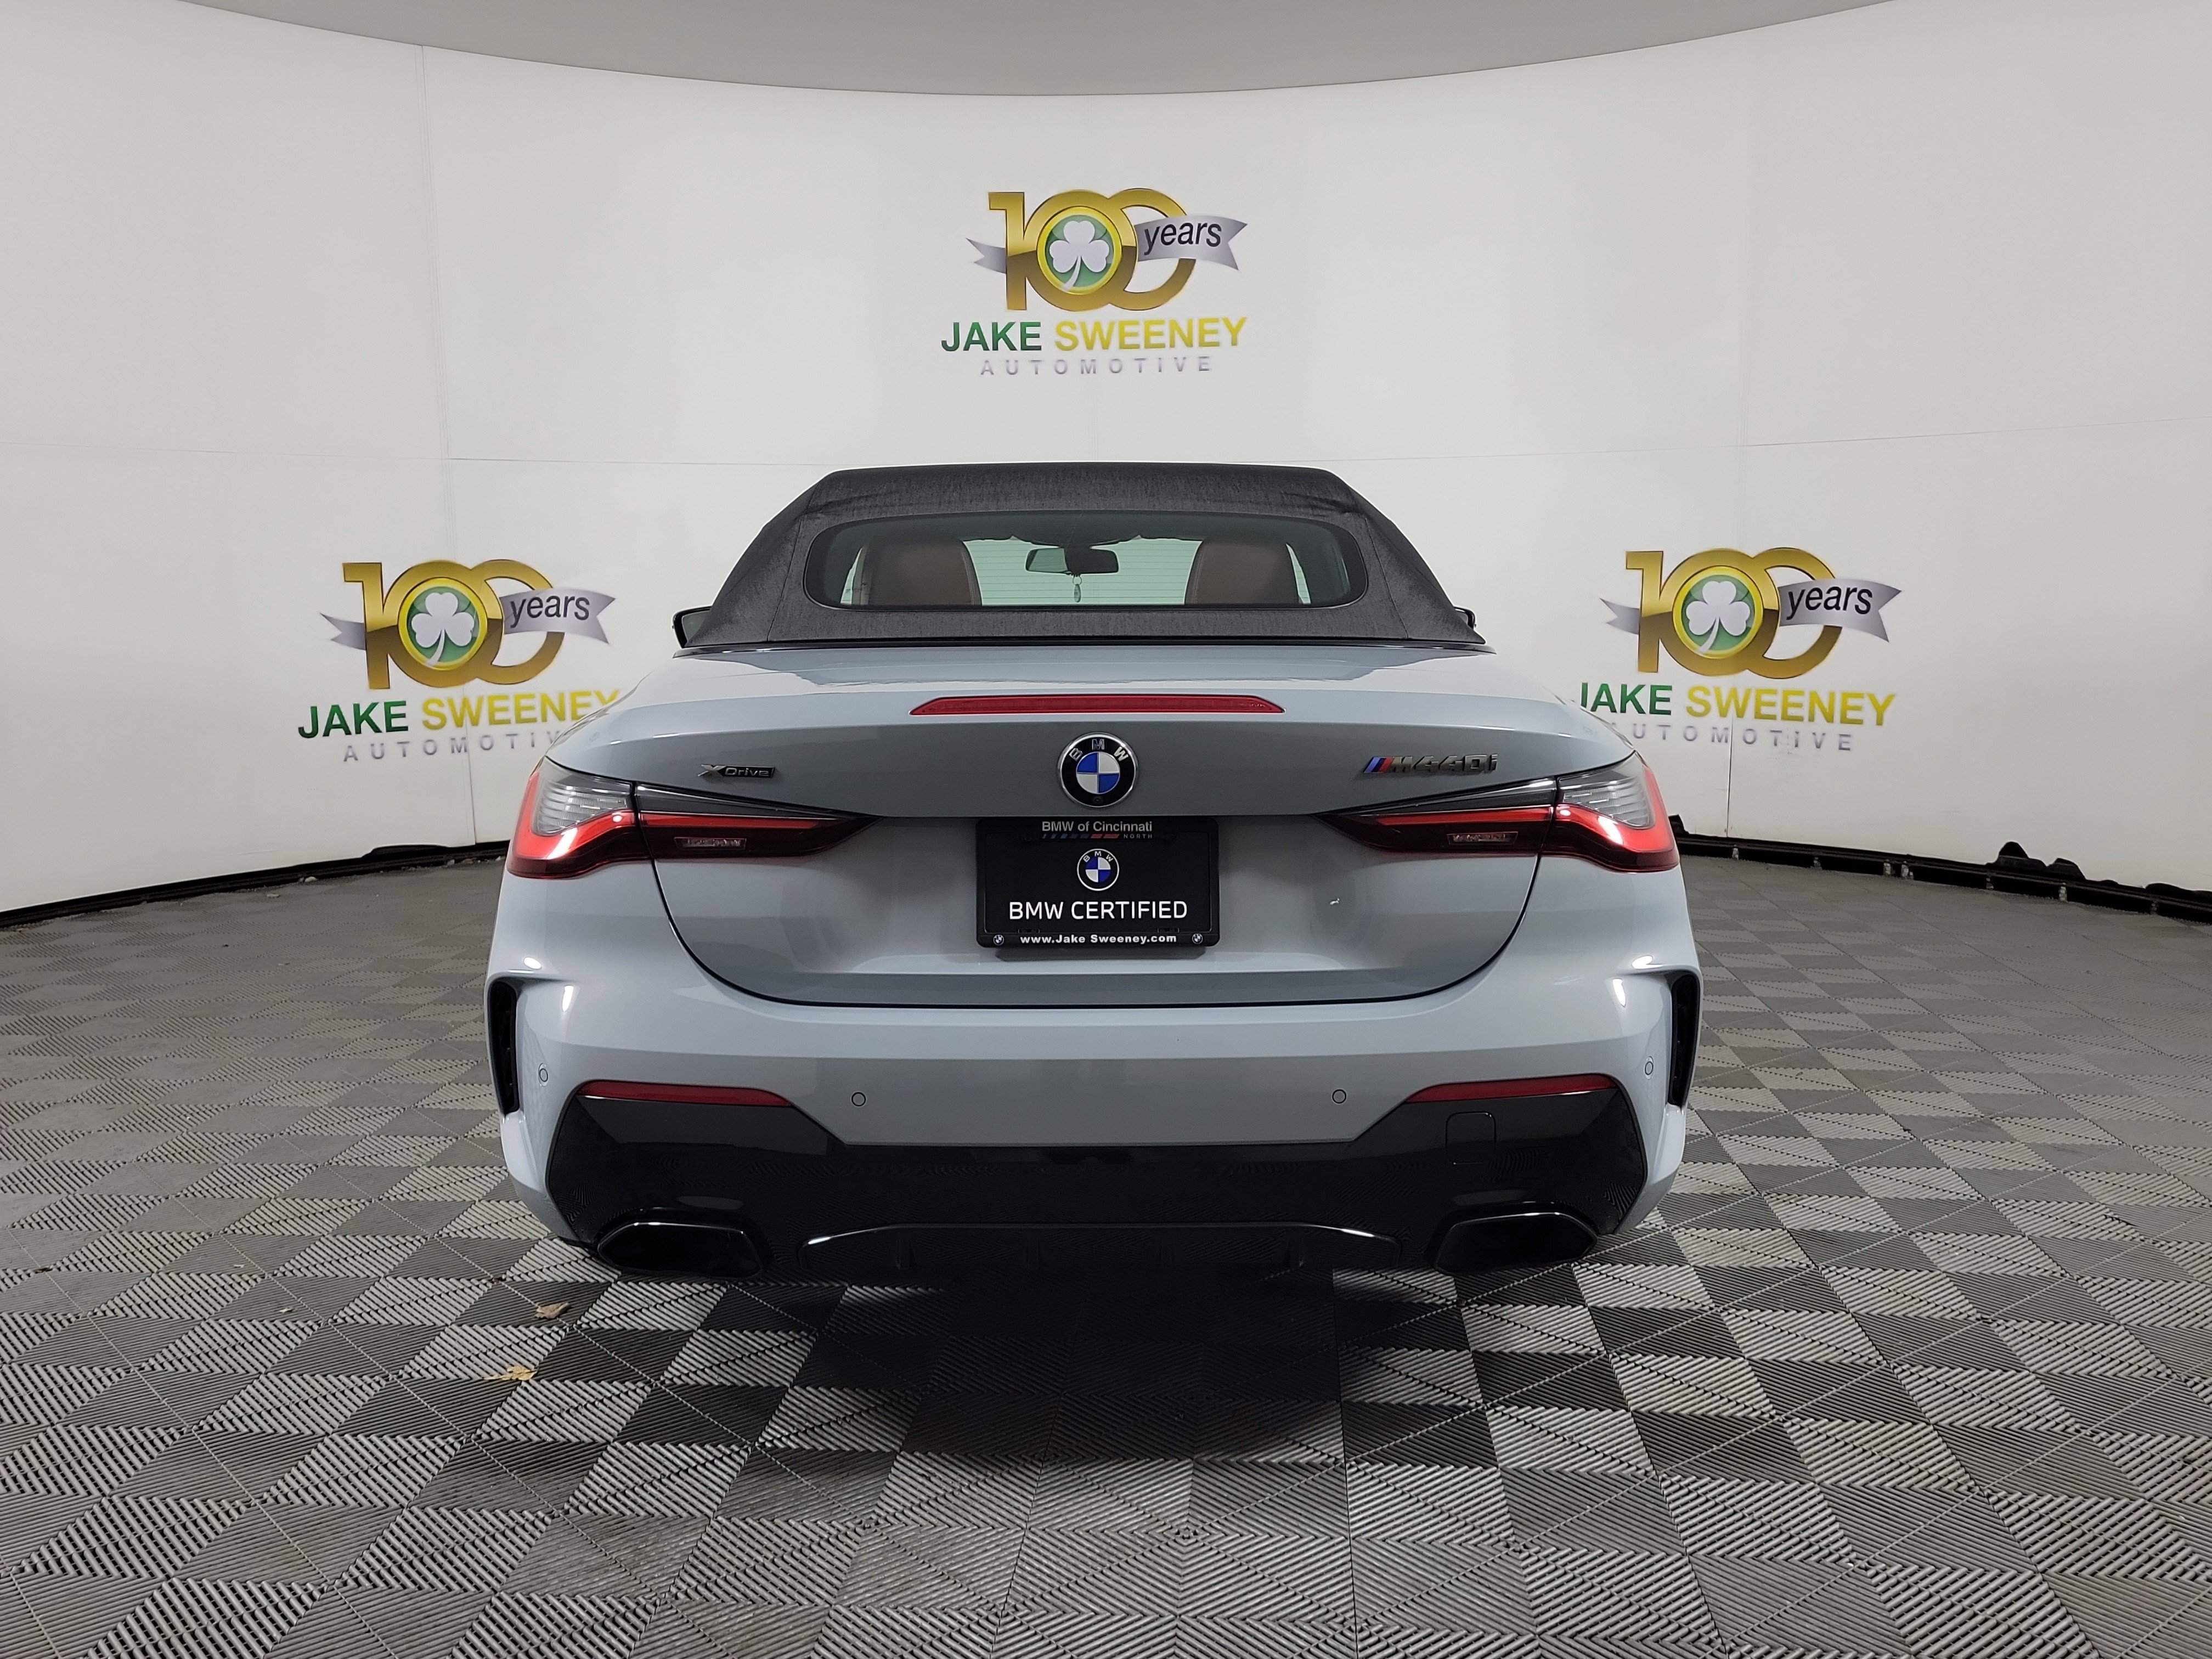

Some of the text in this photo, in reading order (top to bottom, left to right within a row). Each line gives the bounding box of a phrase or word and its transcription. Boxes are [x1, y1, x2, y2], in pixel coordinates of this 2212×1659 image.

[988, 188, 1196, 311] 100
[1143, 222, 1222, 256] years
[941, 317, 1246, 351] JAKE SWEENEY
[981, 356, 1212, 375] AUTOMOTIVE
[510, 596, 590, 628] years
[1626, 548, 1843, 679] 100
[1786, 586, 1874, 620] years
[342, 559, 565, 689] 100
[298, 689, 620, 738] JAKE SWEENEY
[1581, 682, 1897, 726] JAKE SWEENEY
[343, 730, 560, 762] AUTOMOTIV
[1069, 738, 1128, 761] BMW
[1611, 721, 1852, 751] UTOMOTIVE
[1042, 821, 1153, 832] BMW of Cincinnati
[1083, 850, 1114, 863] BMW
[1009, 901, 1187, 919] BMW CERTIFIED
[1020, 934, 1177, 944] www.Jake Sweeney.com
